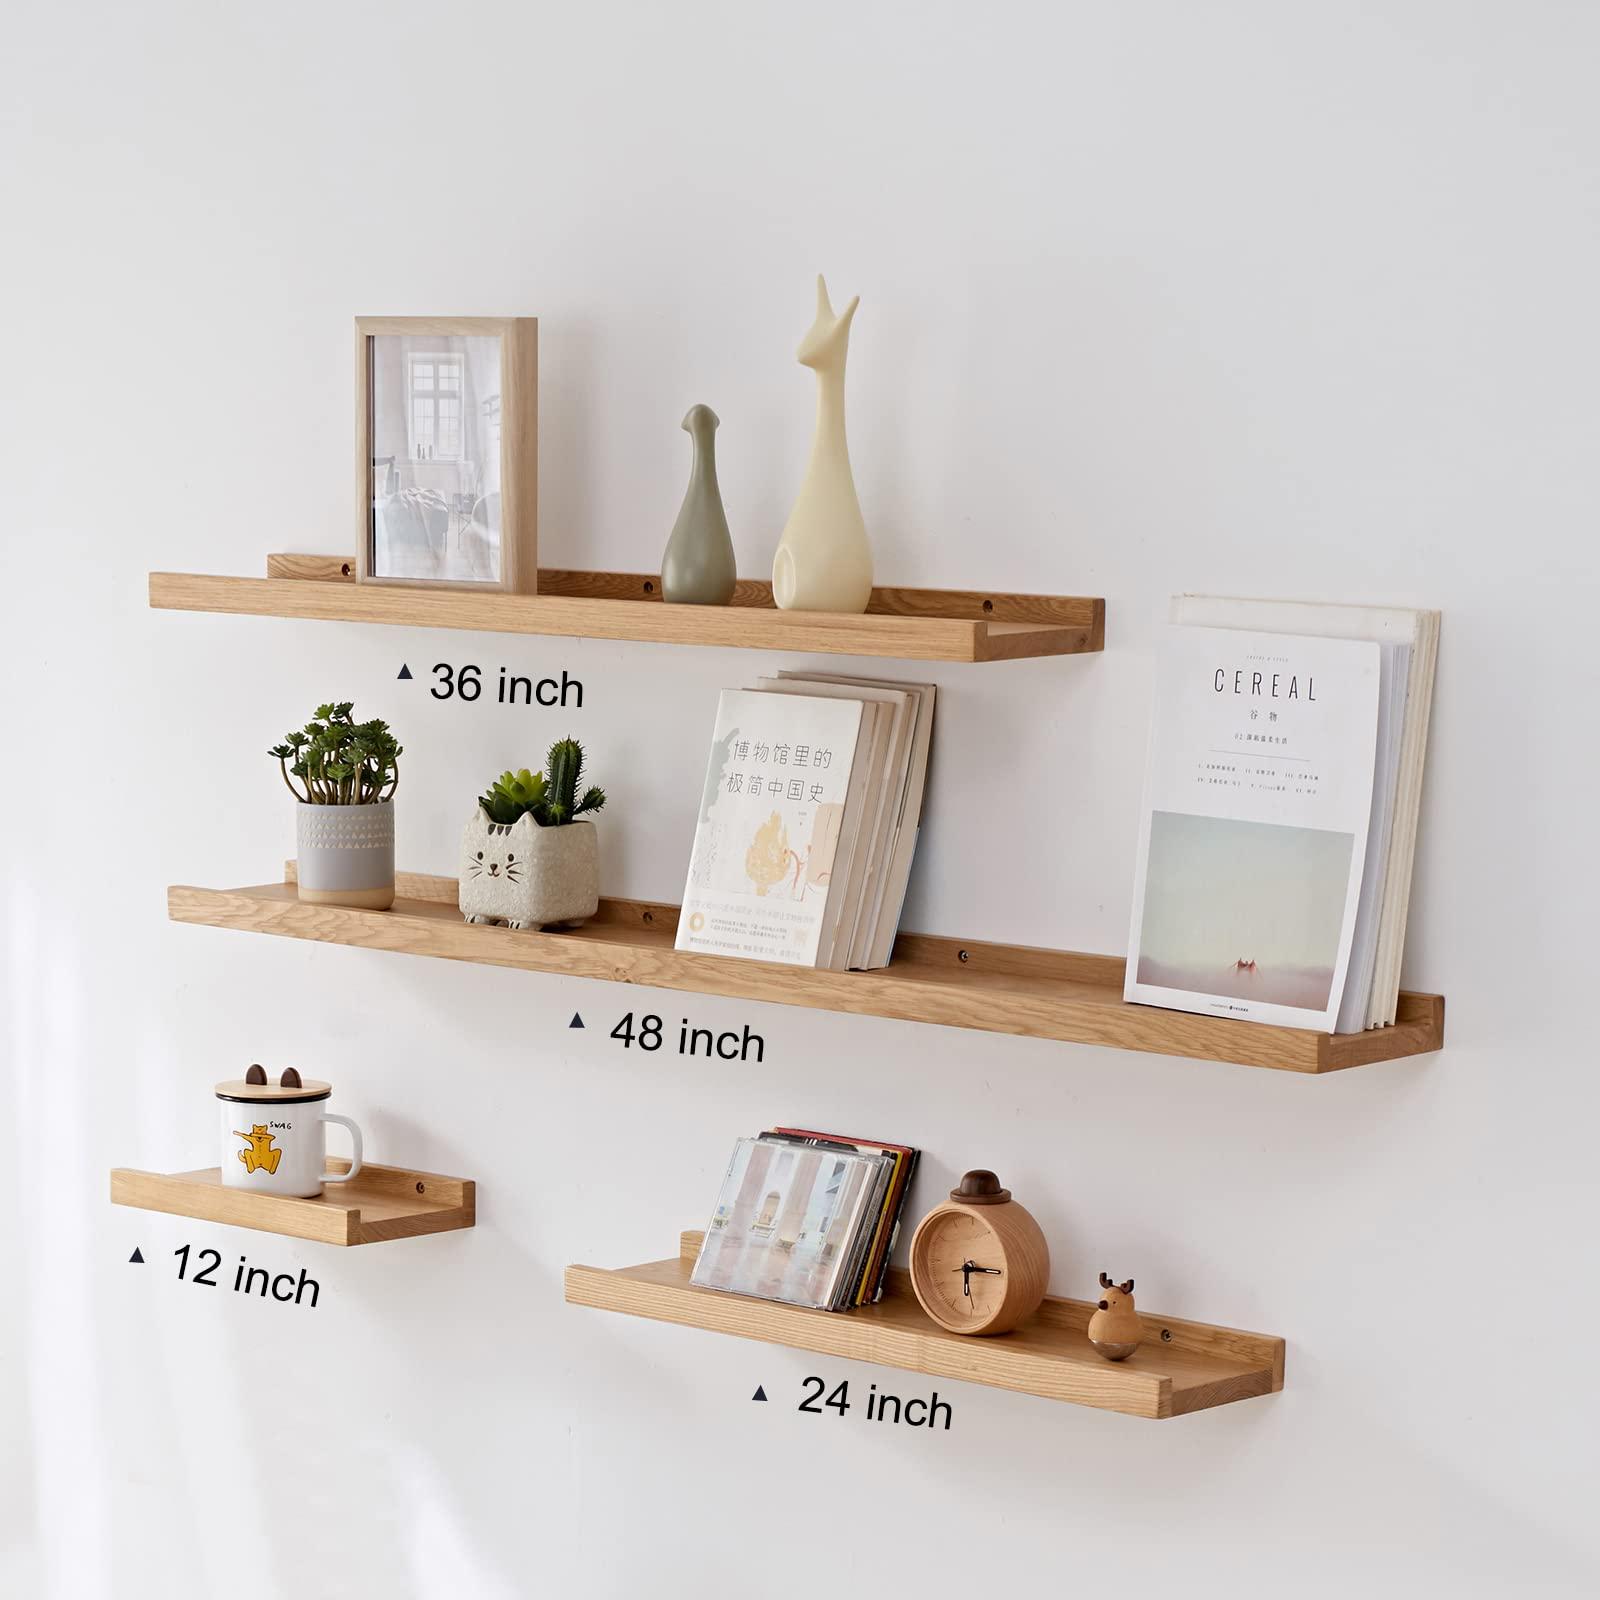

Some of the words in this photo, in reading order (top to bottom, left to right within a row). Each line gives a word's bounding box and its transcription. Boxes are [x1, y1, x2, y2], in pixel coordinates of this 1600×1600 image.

[1214, 668, 1316, 700] CEREAL
[733, 739, 832, 769] 博物馆里的
[726, 771, 824, 803] 极简中国史
[269, 1120, 292, 1130] SWAG
